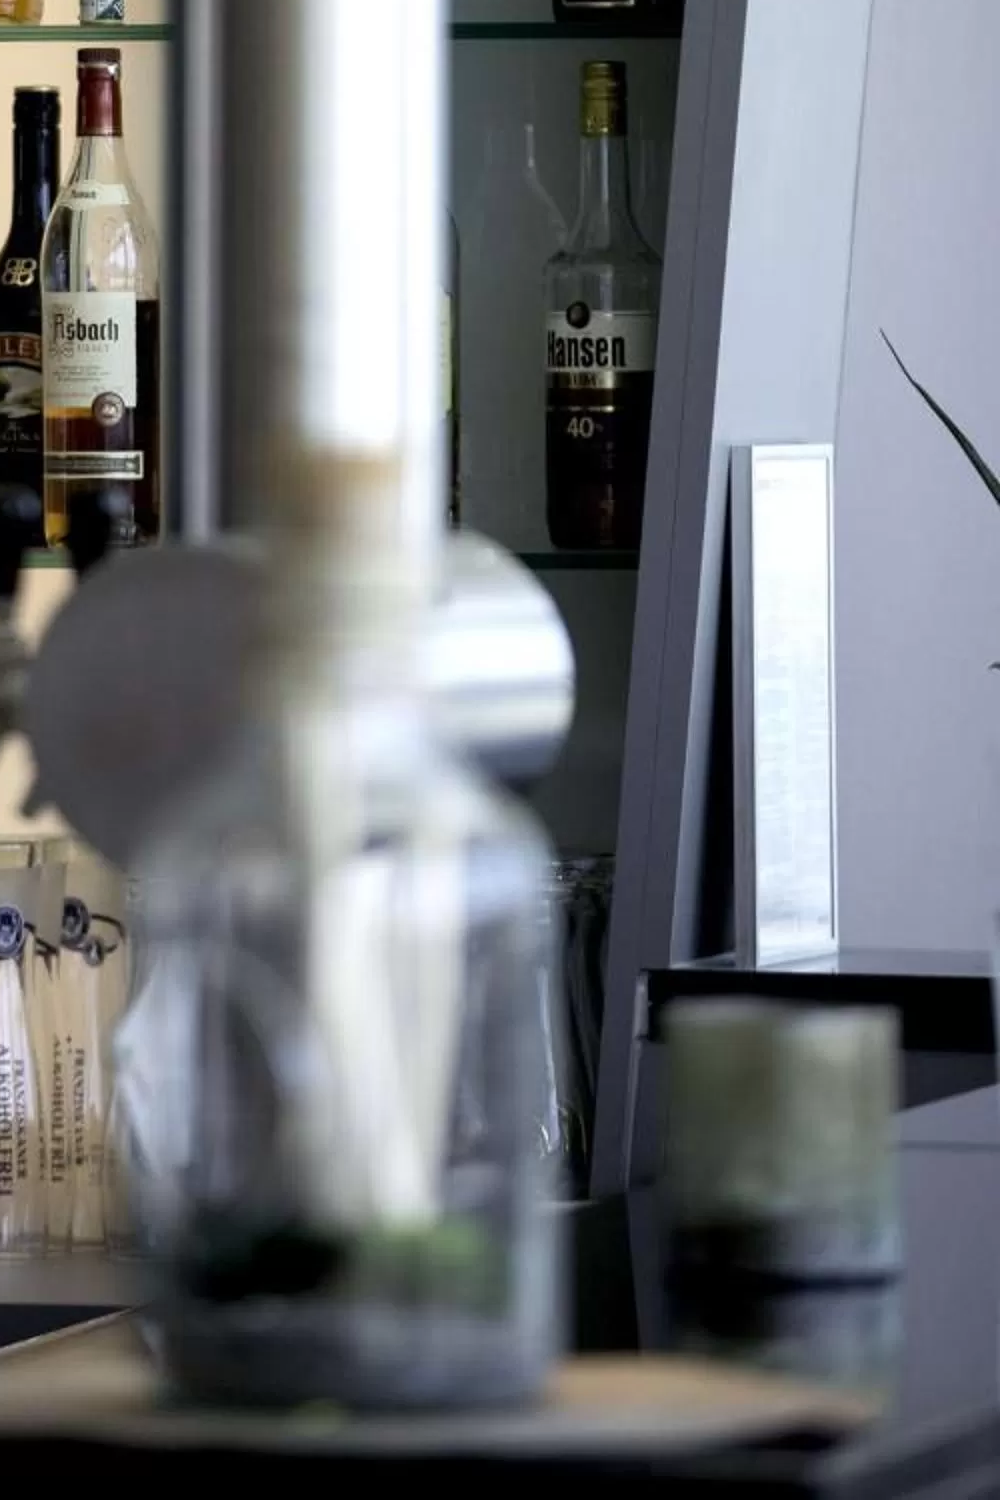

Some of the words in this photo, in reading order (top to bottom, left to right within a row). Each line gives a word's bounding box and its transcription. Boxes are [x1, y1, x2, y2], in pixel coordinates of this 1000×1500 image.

[52, 313, 119, 343] Asbach
[548, 329, 626, 368] Hansen
[13, 1058, 28, 1180] FRANZISKANER
